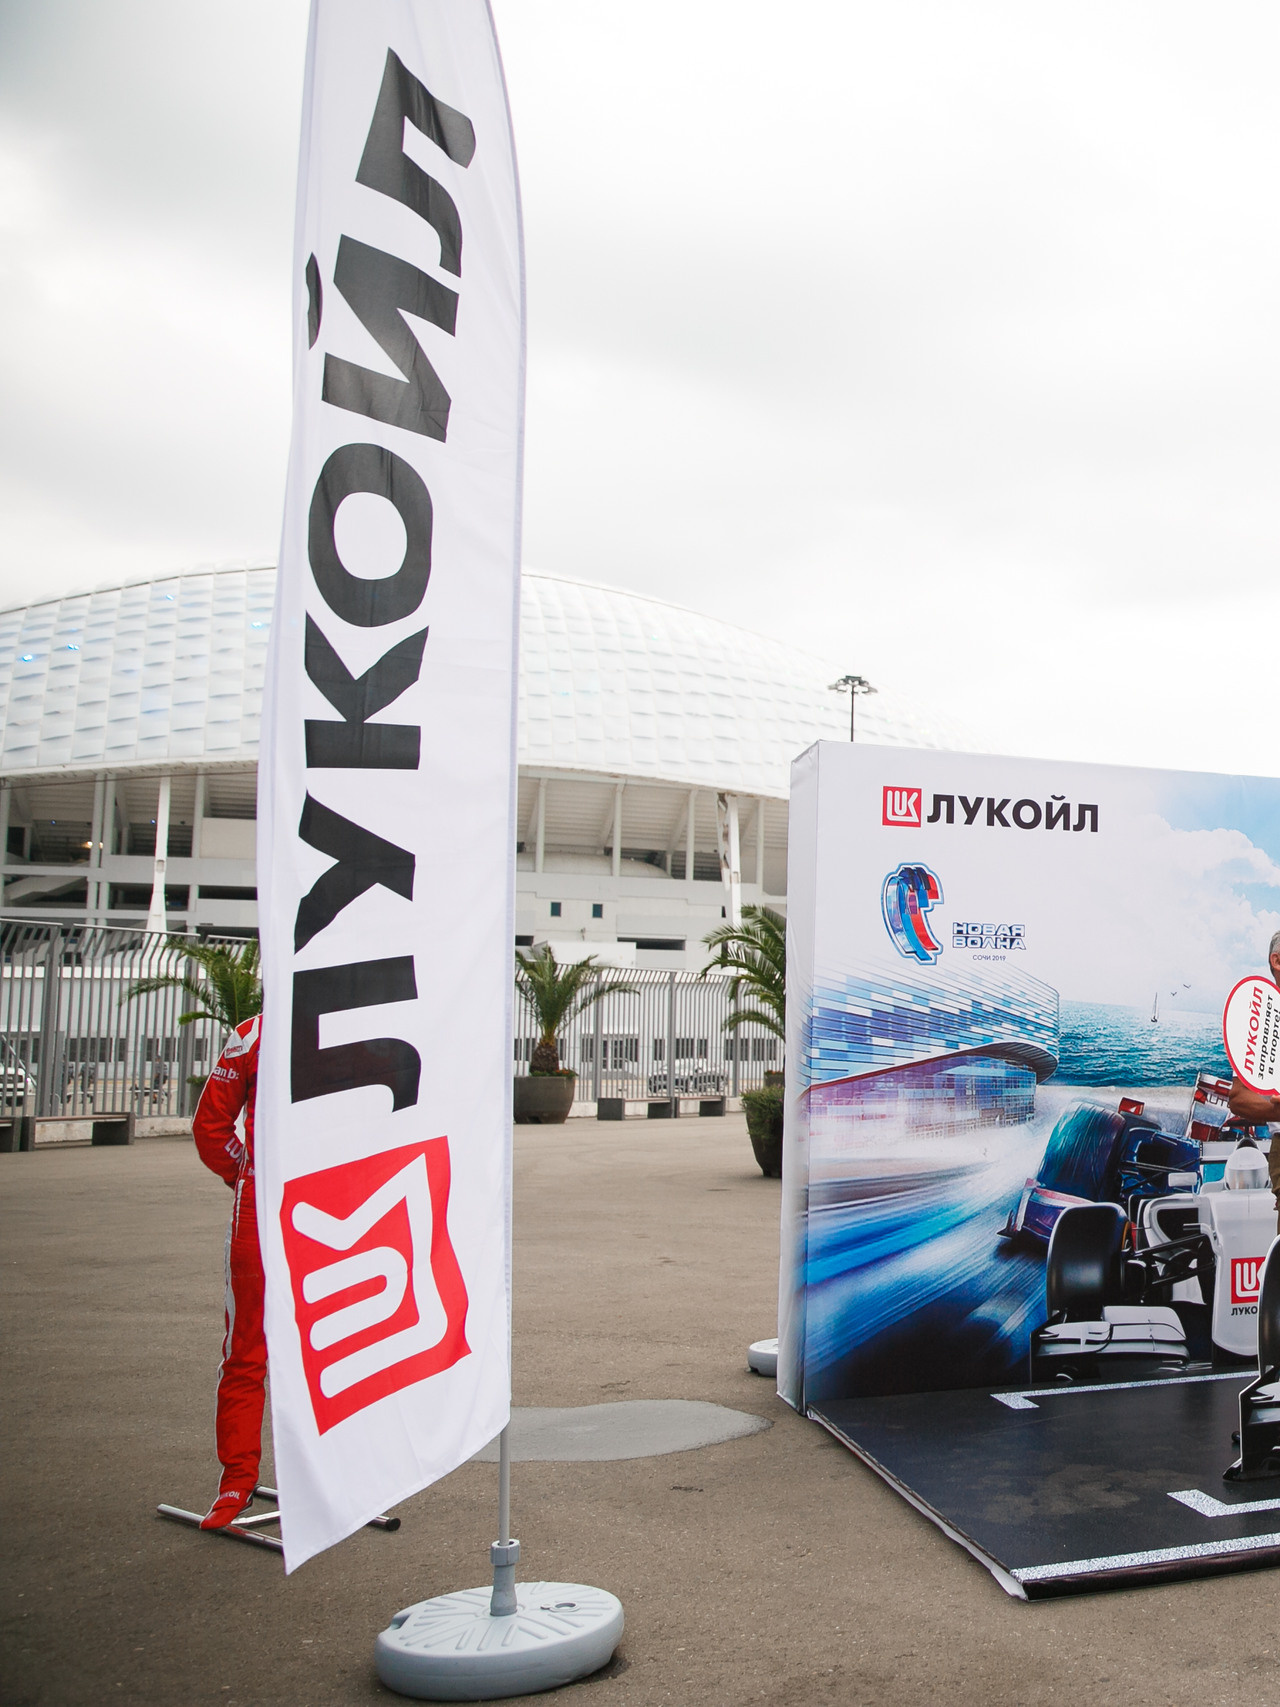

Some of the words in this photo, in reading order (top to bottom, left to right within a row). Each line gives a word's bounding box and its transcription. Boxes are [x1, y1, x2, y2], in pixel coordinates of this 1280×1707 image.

[290, 48, 478, 1114] ЛУКОЙЛ
[927, 794, 1099, 832] ЛУКОЙЛ
[952, 922, 1025, 937] НОВАЯ
[952, 936, 1026, 950] ВОЛНА
[1244, 986, 1263, 1075] ЛУКОЙЛ
[1258, 994, 1274, 1080] заправляет
[1270, 1008, 1280, 1063] спорте!
[1231, 1306, 1258, 1316] ЛУКО
